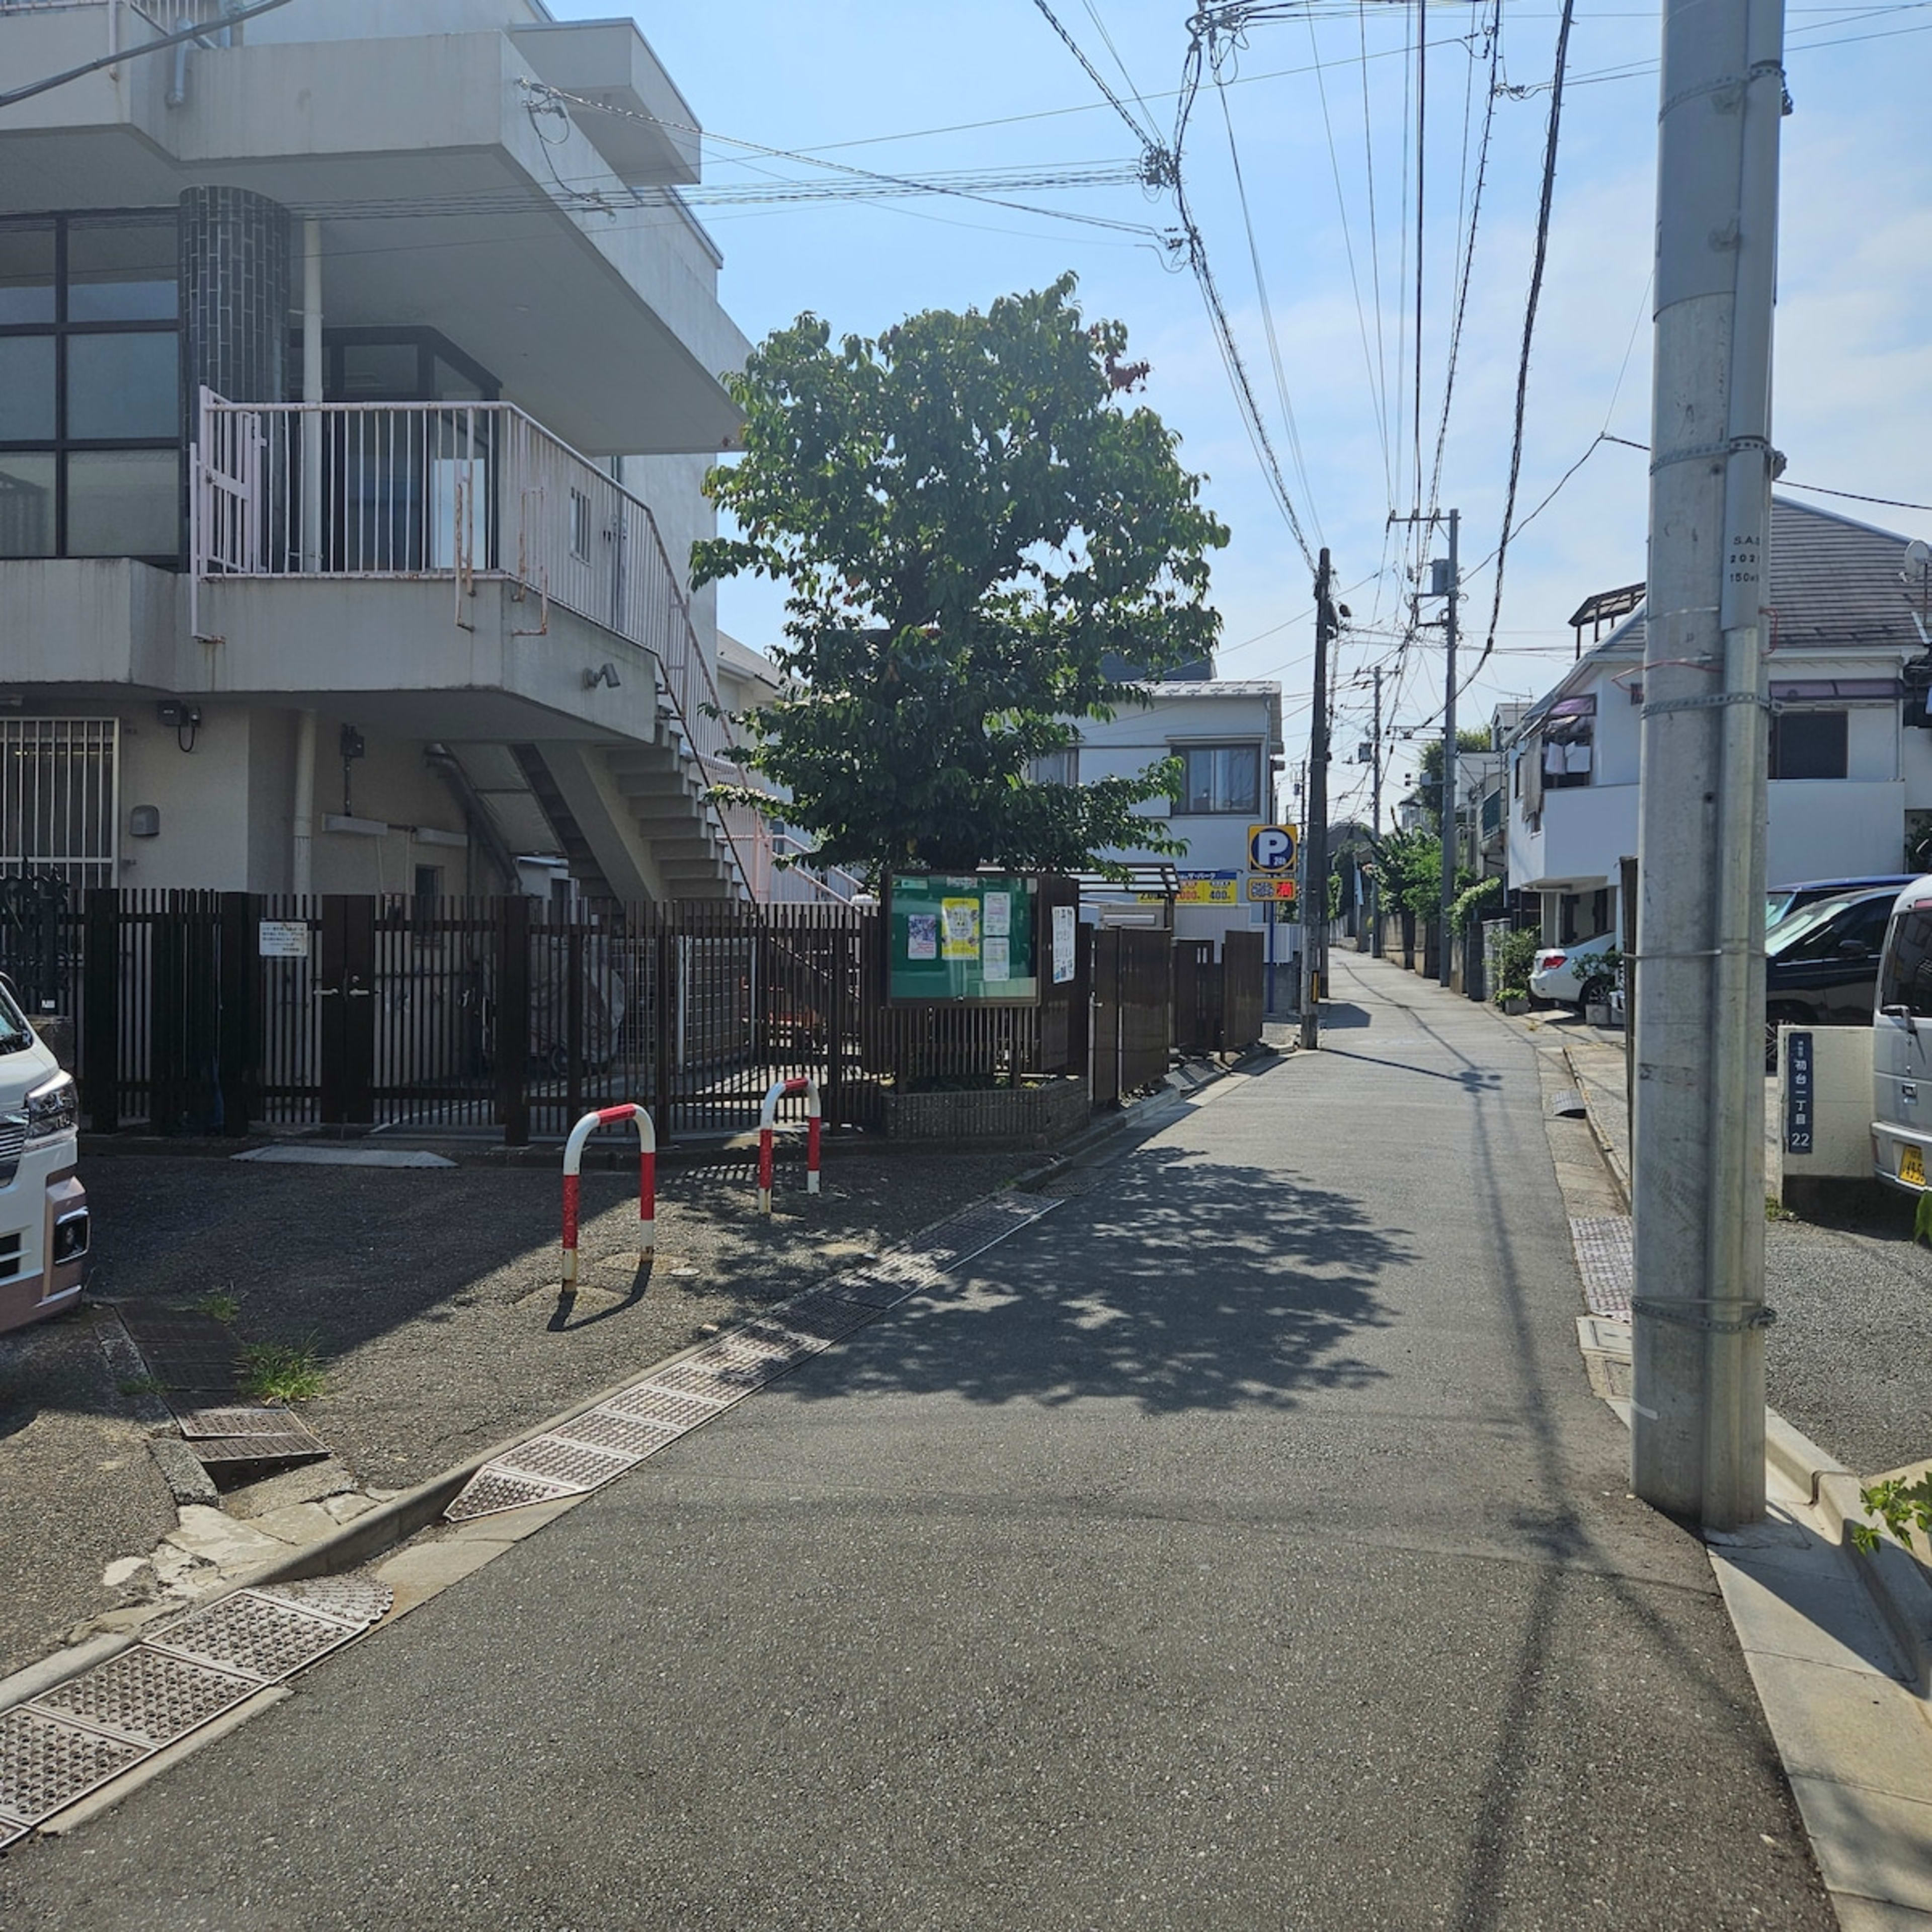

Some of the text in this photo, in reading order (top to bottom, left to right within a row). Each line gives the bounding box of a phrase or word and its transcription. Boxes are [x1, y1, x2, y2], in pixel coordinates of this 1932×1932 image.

[1258, 832, 1289, 865] P
[1794, 1060, 1807, 1125] 初台一丁目
[1791, 1133, 1810, 1147] 22
